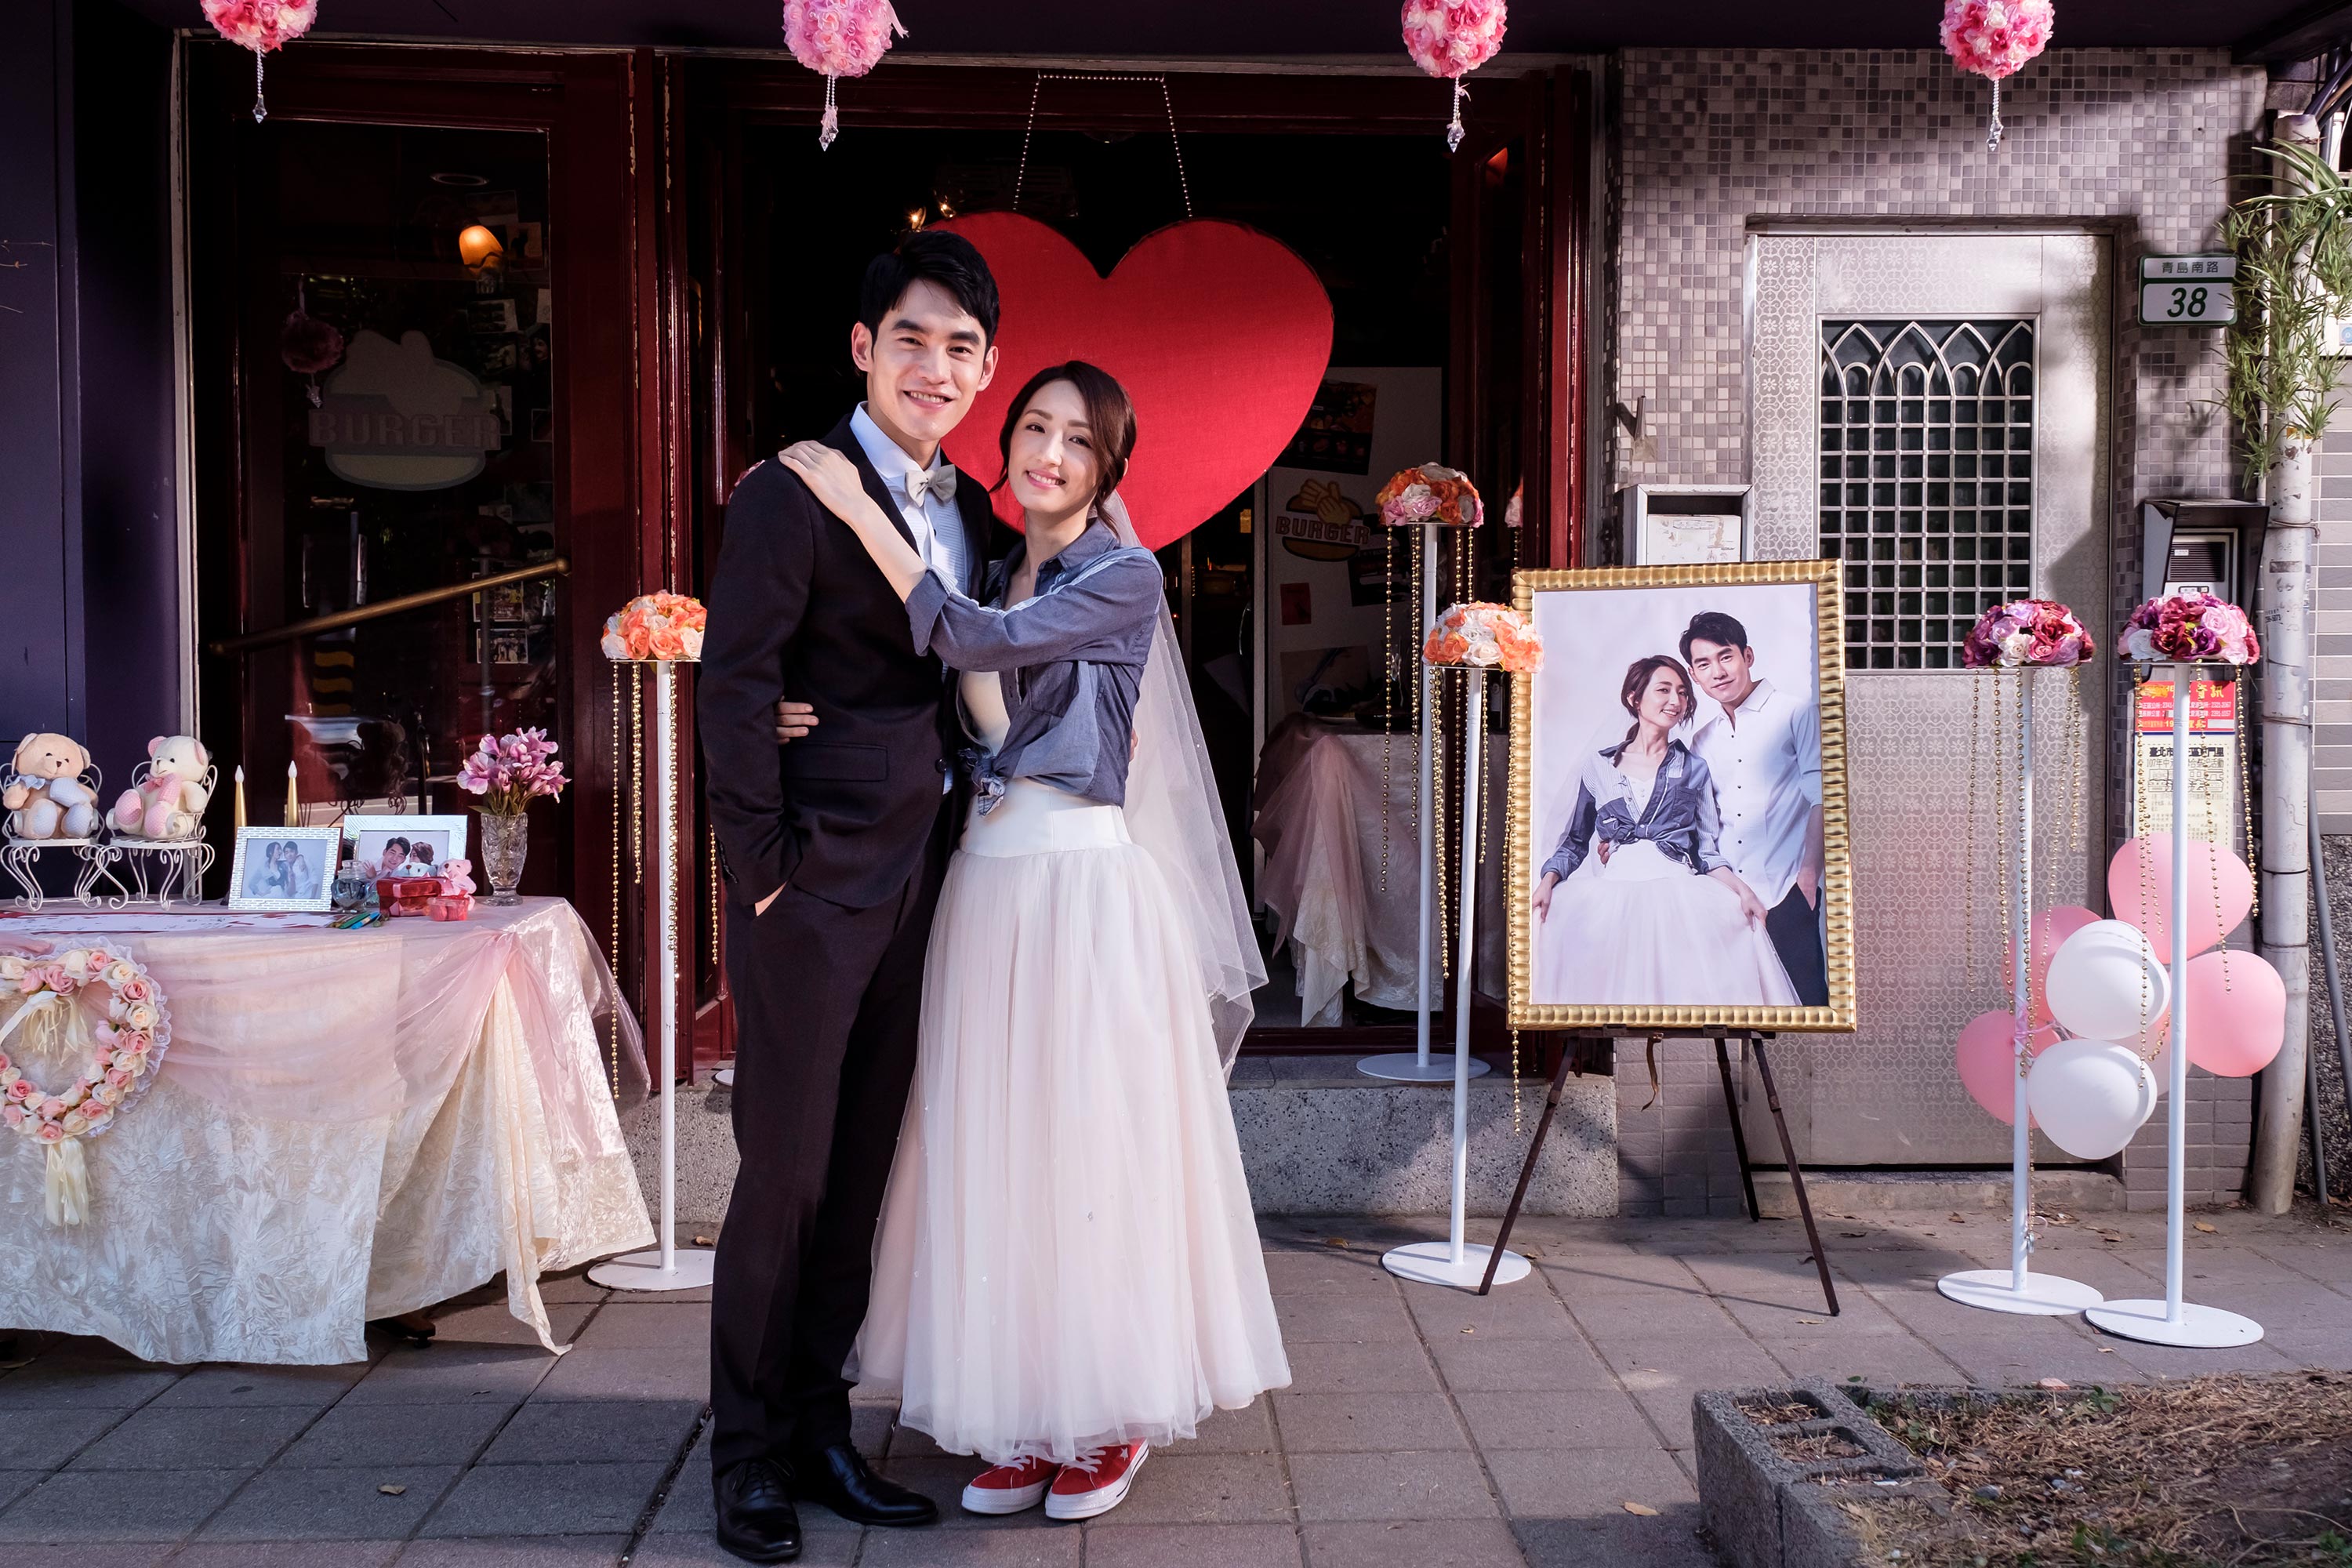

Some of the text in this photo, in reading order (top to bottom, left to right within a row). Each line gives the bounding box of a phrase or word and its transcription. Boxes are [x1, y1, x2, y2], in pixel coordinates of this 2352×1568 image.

[2161, 261, 2219, 274] 青島南路
[2167, 287, 2208, 318] 38
[309, 408, 502, 451] BURGER
[1275, 516, 1370, 545] BURGER
